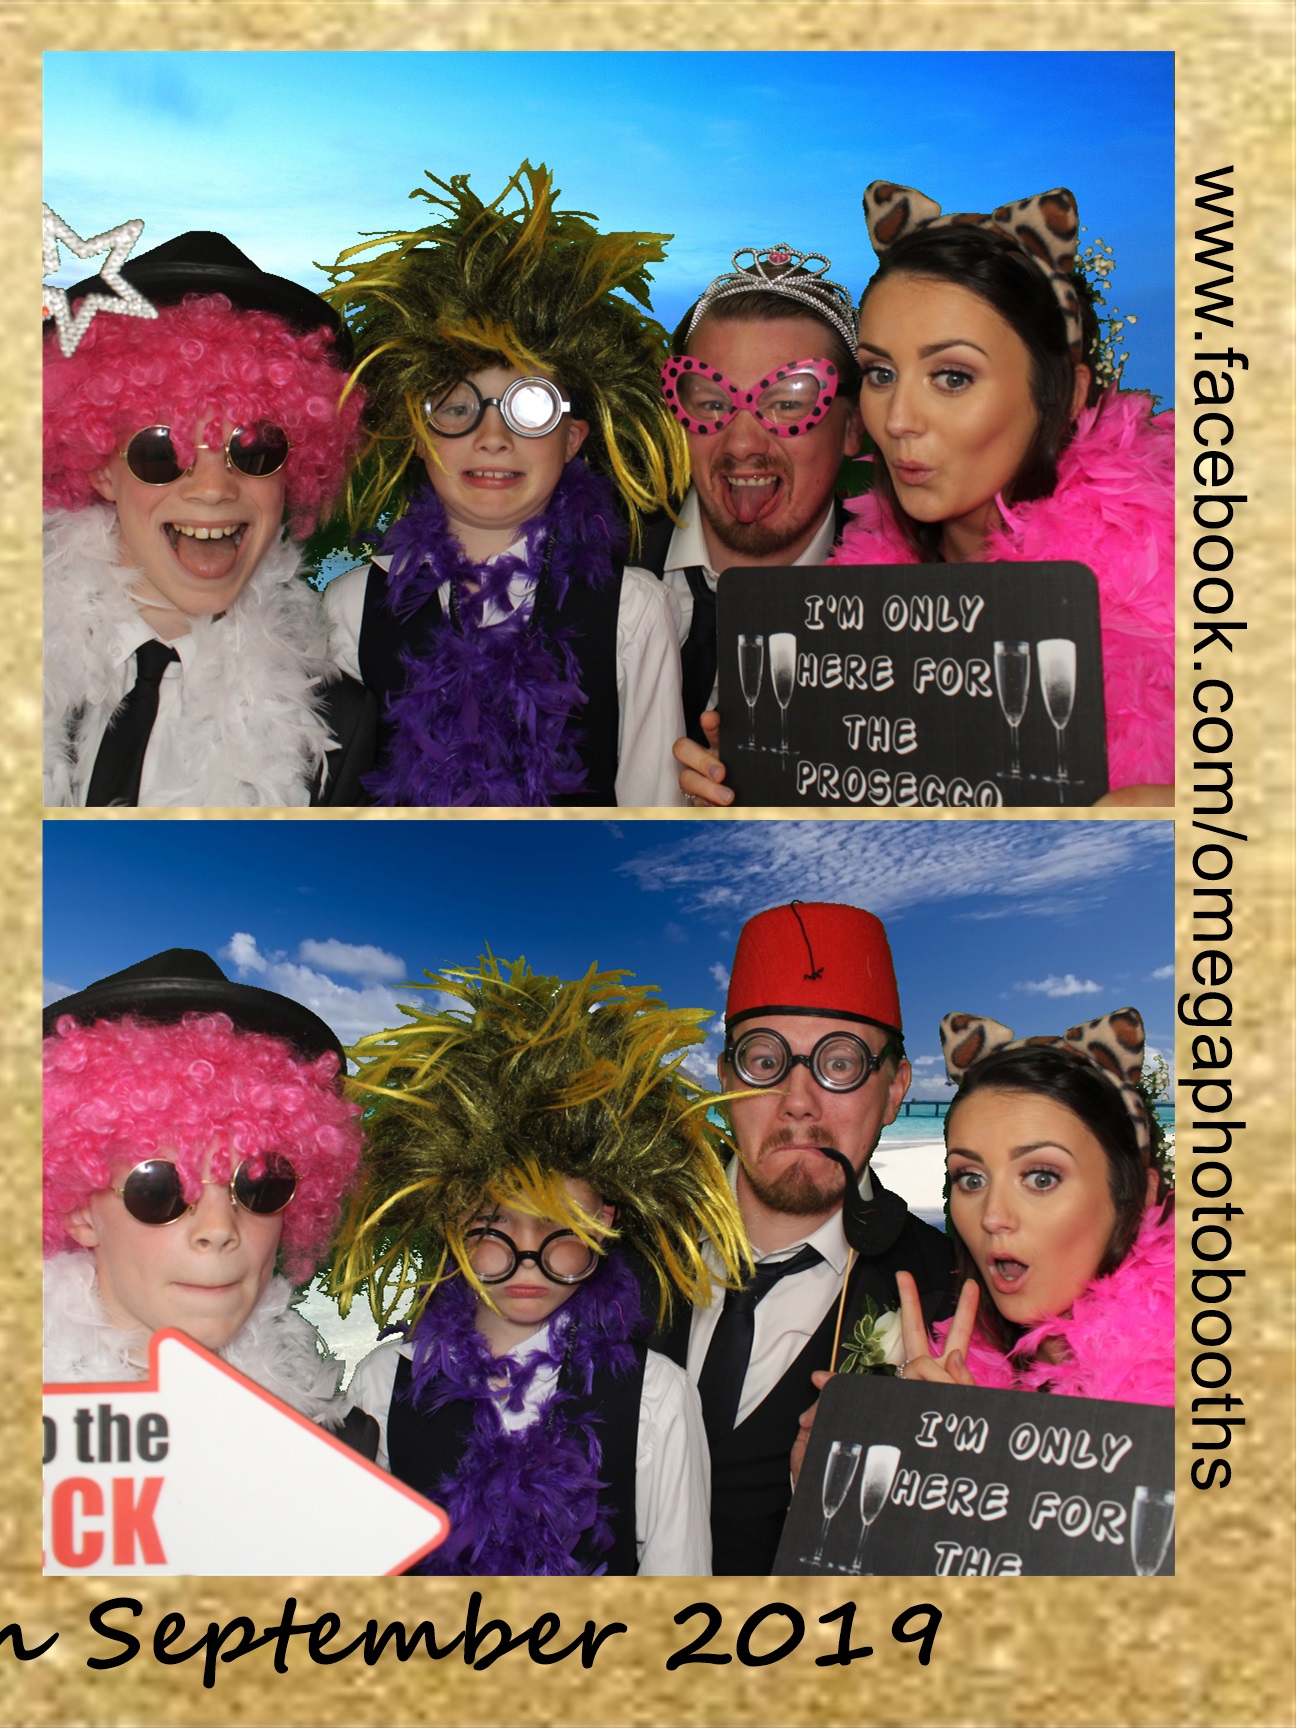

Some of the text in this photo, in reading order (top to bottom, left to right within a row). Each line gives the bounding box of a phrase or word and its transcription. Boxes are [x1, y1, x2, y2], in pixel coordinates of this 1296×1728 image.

[804, 594, 985, 634] I'M ONLY
[796, 653, 993, 698] HERE FOR
[843, 714, 918, 756] THE
[796, 760, 1004, 807] PROSECCO
[74, 1403, 170, 1464] the
[914, 1411, 1134, 1474] I'M ONLY
[891, 1468, 1128, 1546] HERE FOR
[934, 1540, 1024, 1576] THE
